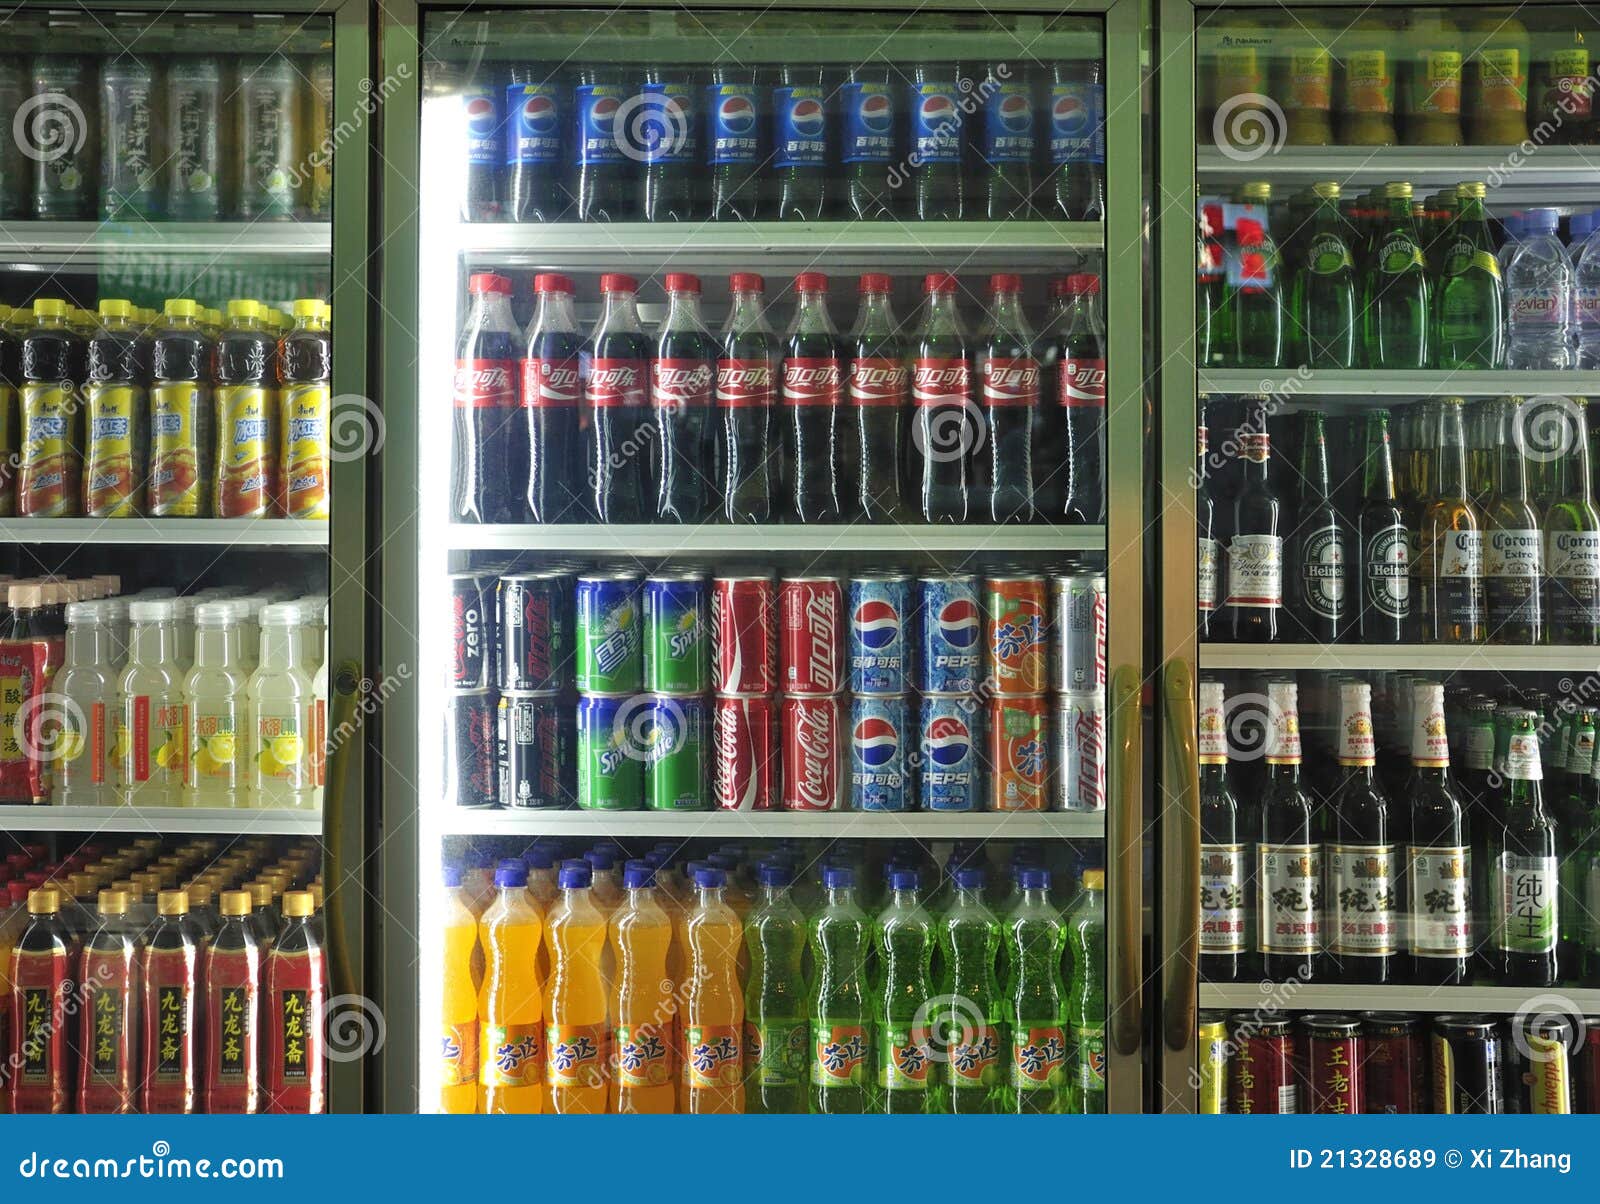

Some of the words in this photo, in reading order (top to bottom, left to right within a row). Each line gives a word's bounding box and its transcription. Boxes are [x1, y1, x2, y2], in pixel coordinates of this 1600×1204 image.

[716, 138, 757, 149] 百事可乐
[787, 141, 827, 152] 百事可乐
[1519, 296, 1555, 311] evian
[717, 366, 775, 387] 可口可乐
[787, 366, 841, 387] 可口可乐
[465, 609, 480, 658] zero
[852, 656, 900, 668] 百事可乐
[852, 772, 901, 786] 百事可乐
[1516, 873, 1544, 939] 纯生
[95, 991, 116, 1061] 九龙斋
[160, 991, 181, 1061] 九龙斋
[223, 992, 243, 1061] 九龙斋
[284, 994, 305, 1064] 九龙斋
[497, 1036, 538, 1071] 芬达
[553, 1036, 597, 1071] 芬达
[622, 1037, 666, 1071] 芬达
[693, 1036, 738, 1072] 芬达
[823, 1035, 868, 1071] 芬达
[1020, 1038, 1065, 1074] 芬达
